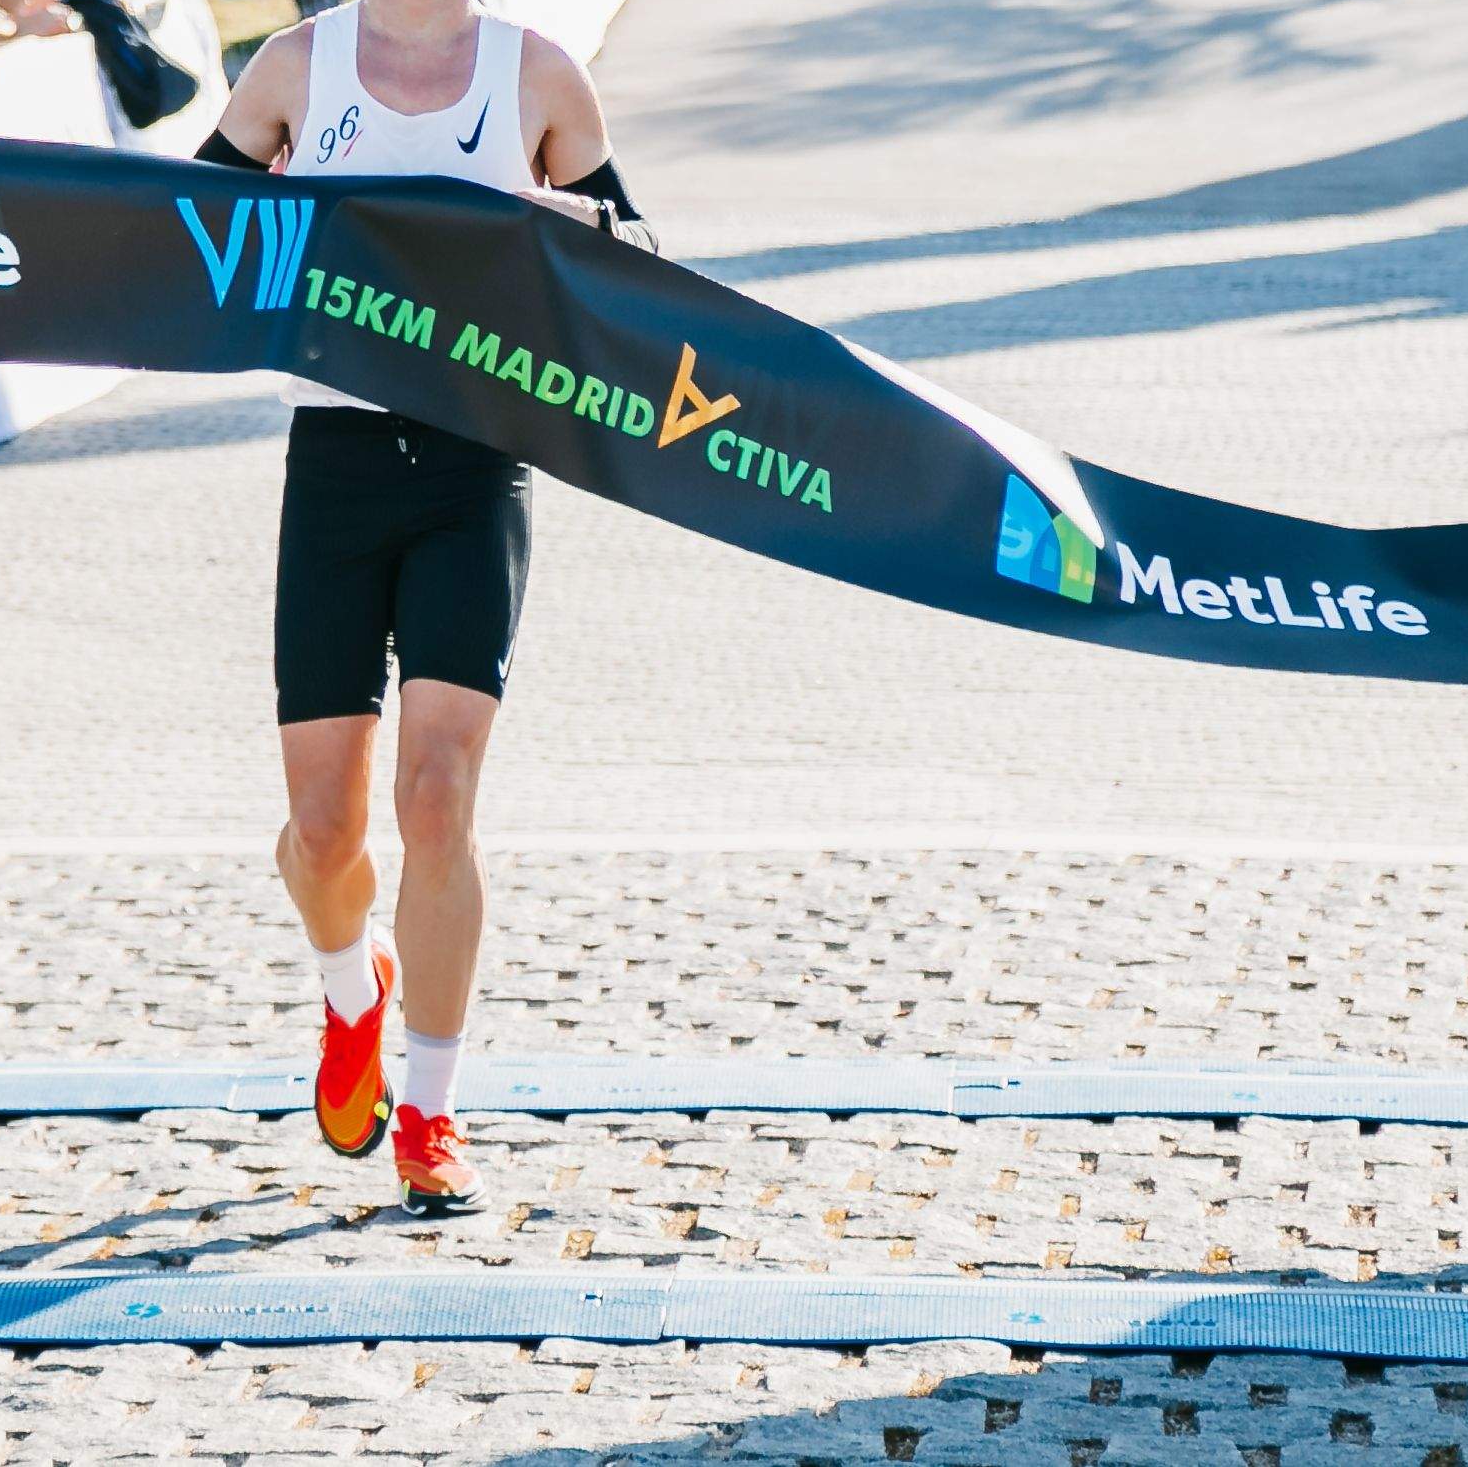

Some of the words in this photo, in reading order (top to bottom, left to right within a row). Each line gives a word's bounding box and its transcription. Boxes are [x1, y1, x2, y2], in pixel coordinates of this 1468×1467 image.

[176, 198, 315, 311] VIII
[304, 268, 436, 351] 15KM
[449, 323, 656, 439] MADRID
[1115, 541, 1431, 637] MetLife
